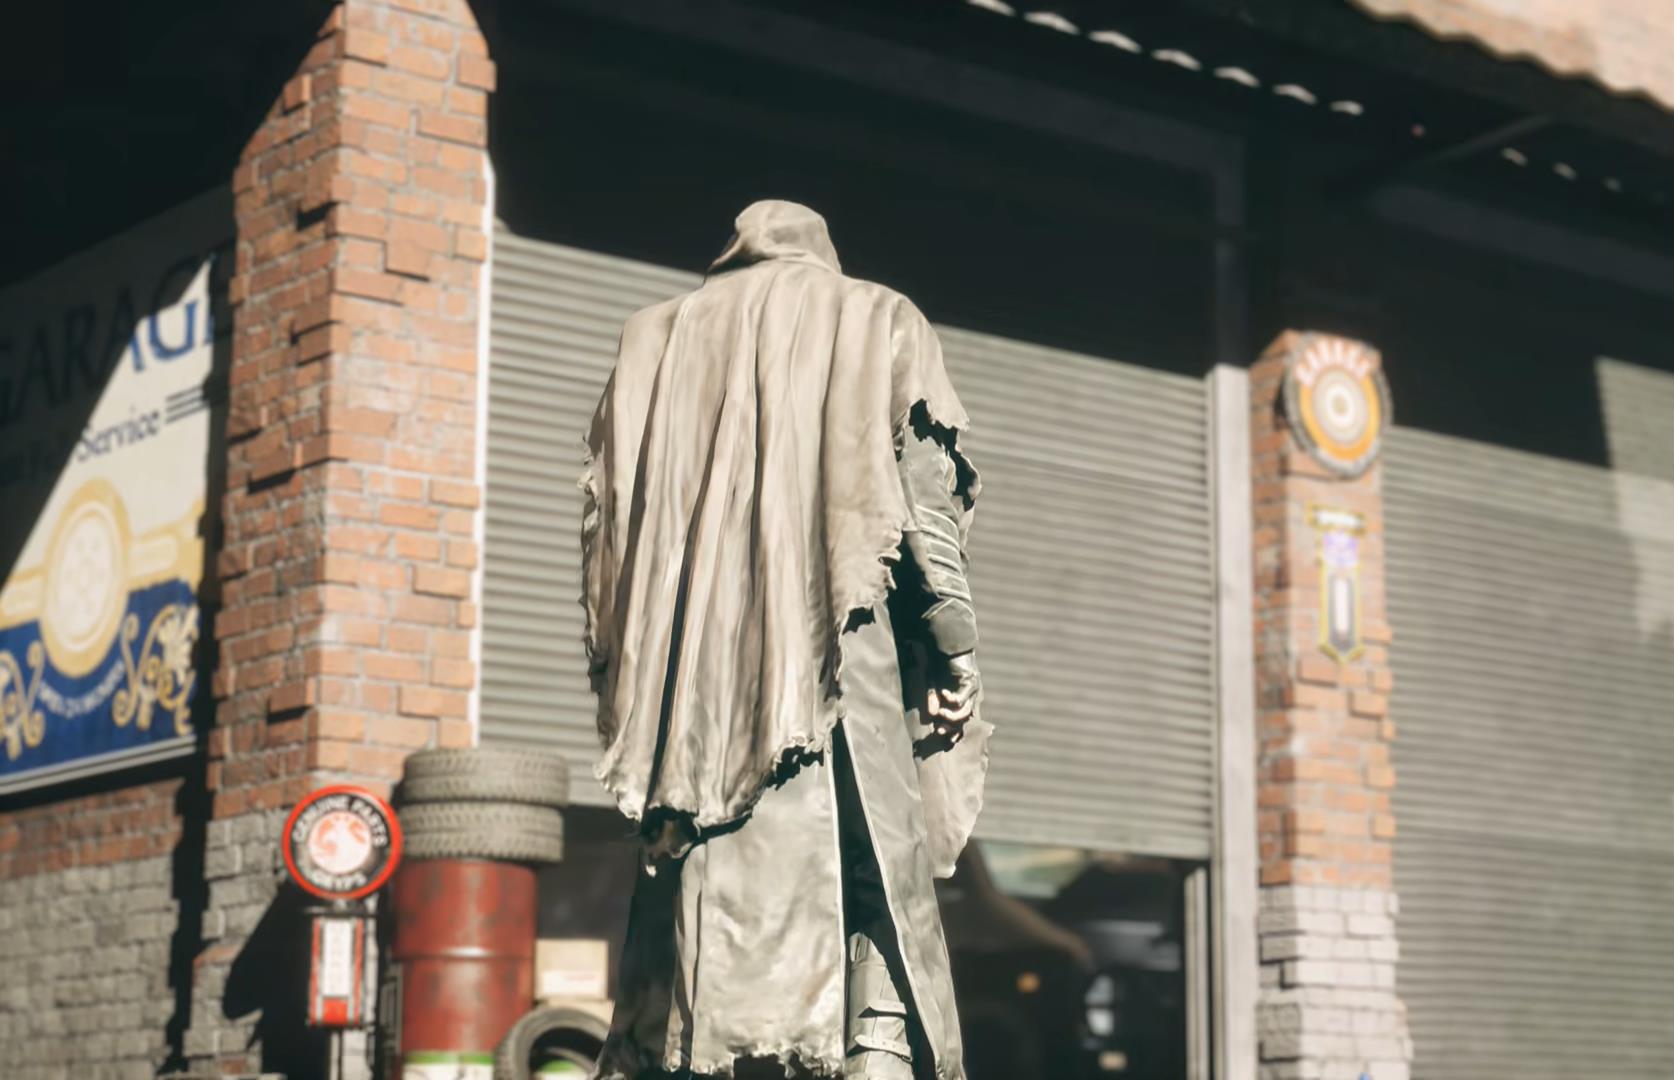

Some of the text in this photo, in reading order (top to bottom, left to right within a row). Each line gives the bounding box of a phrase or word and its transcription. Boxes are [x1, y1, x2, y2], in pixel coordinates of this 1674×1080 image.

[76, 405, 160, 462] Service
[292, 795, 388, 847] GENUINE PARTS
